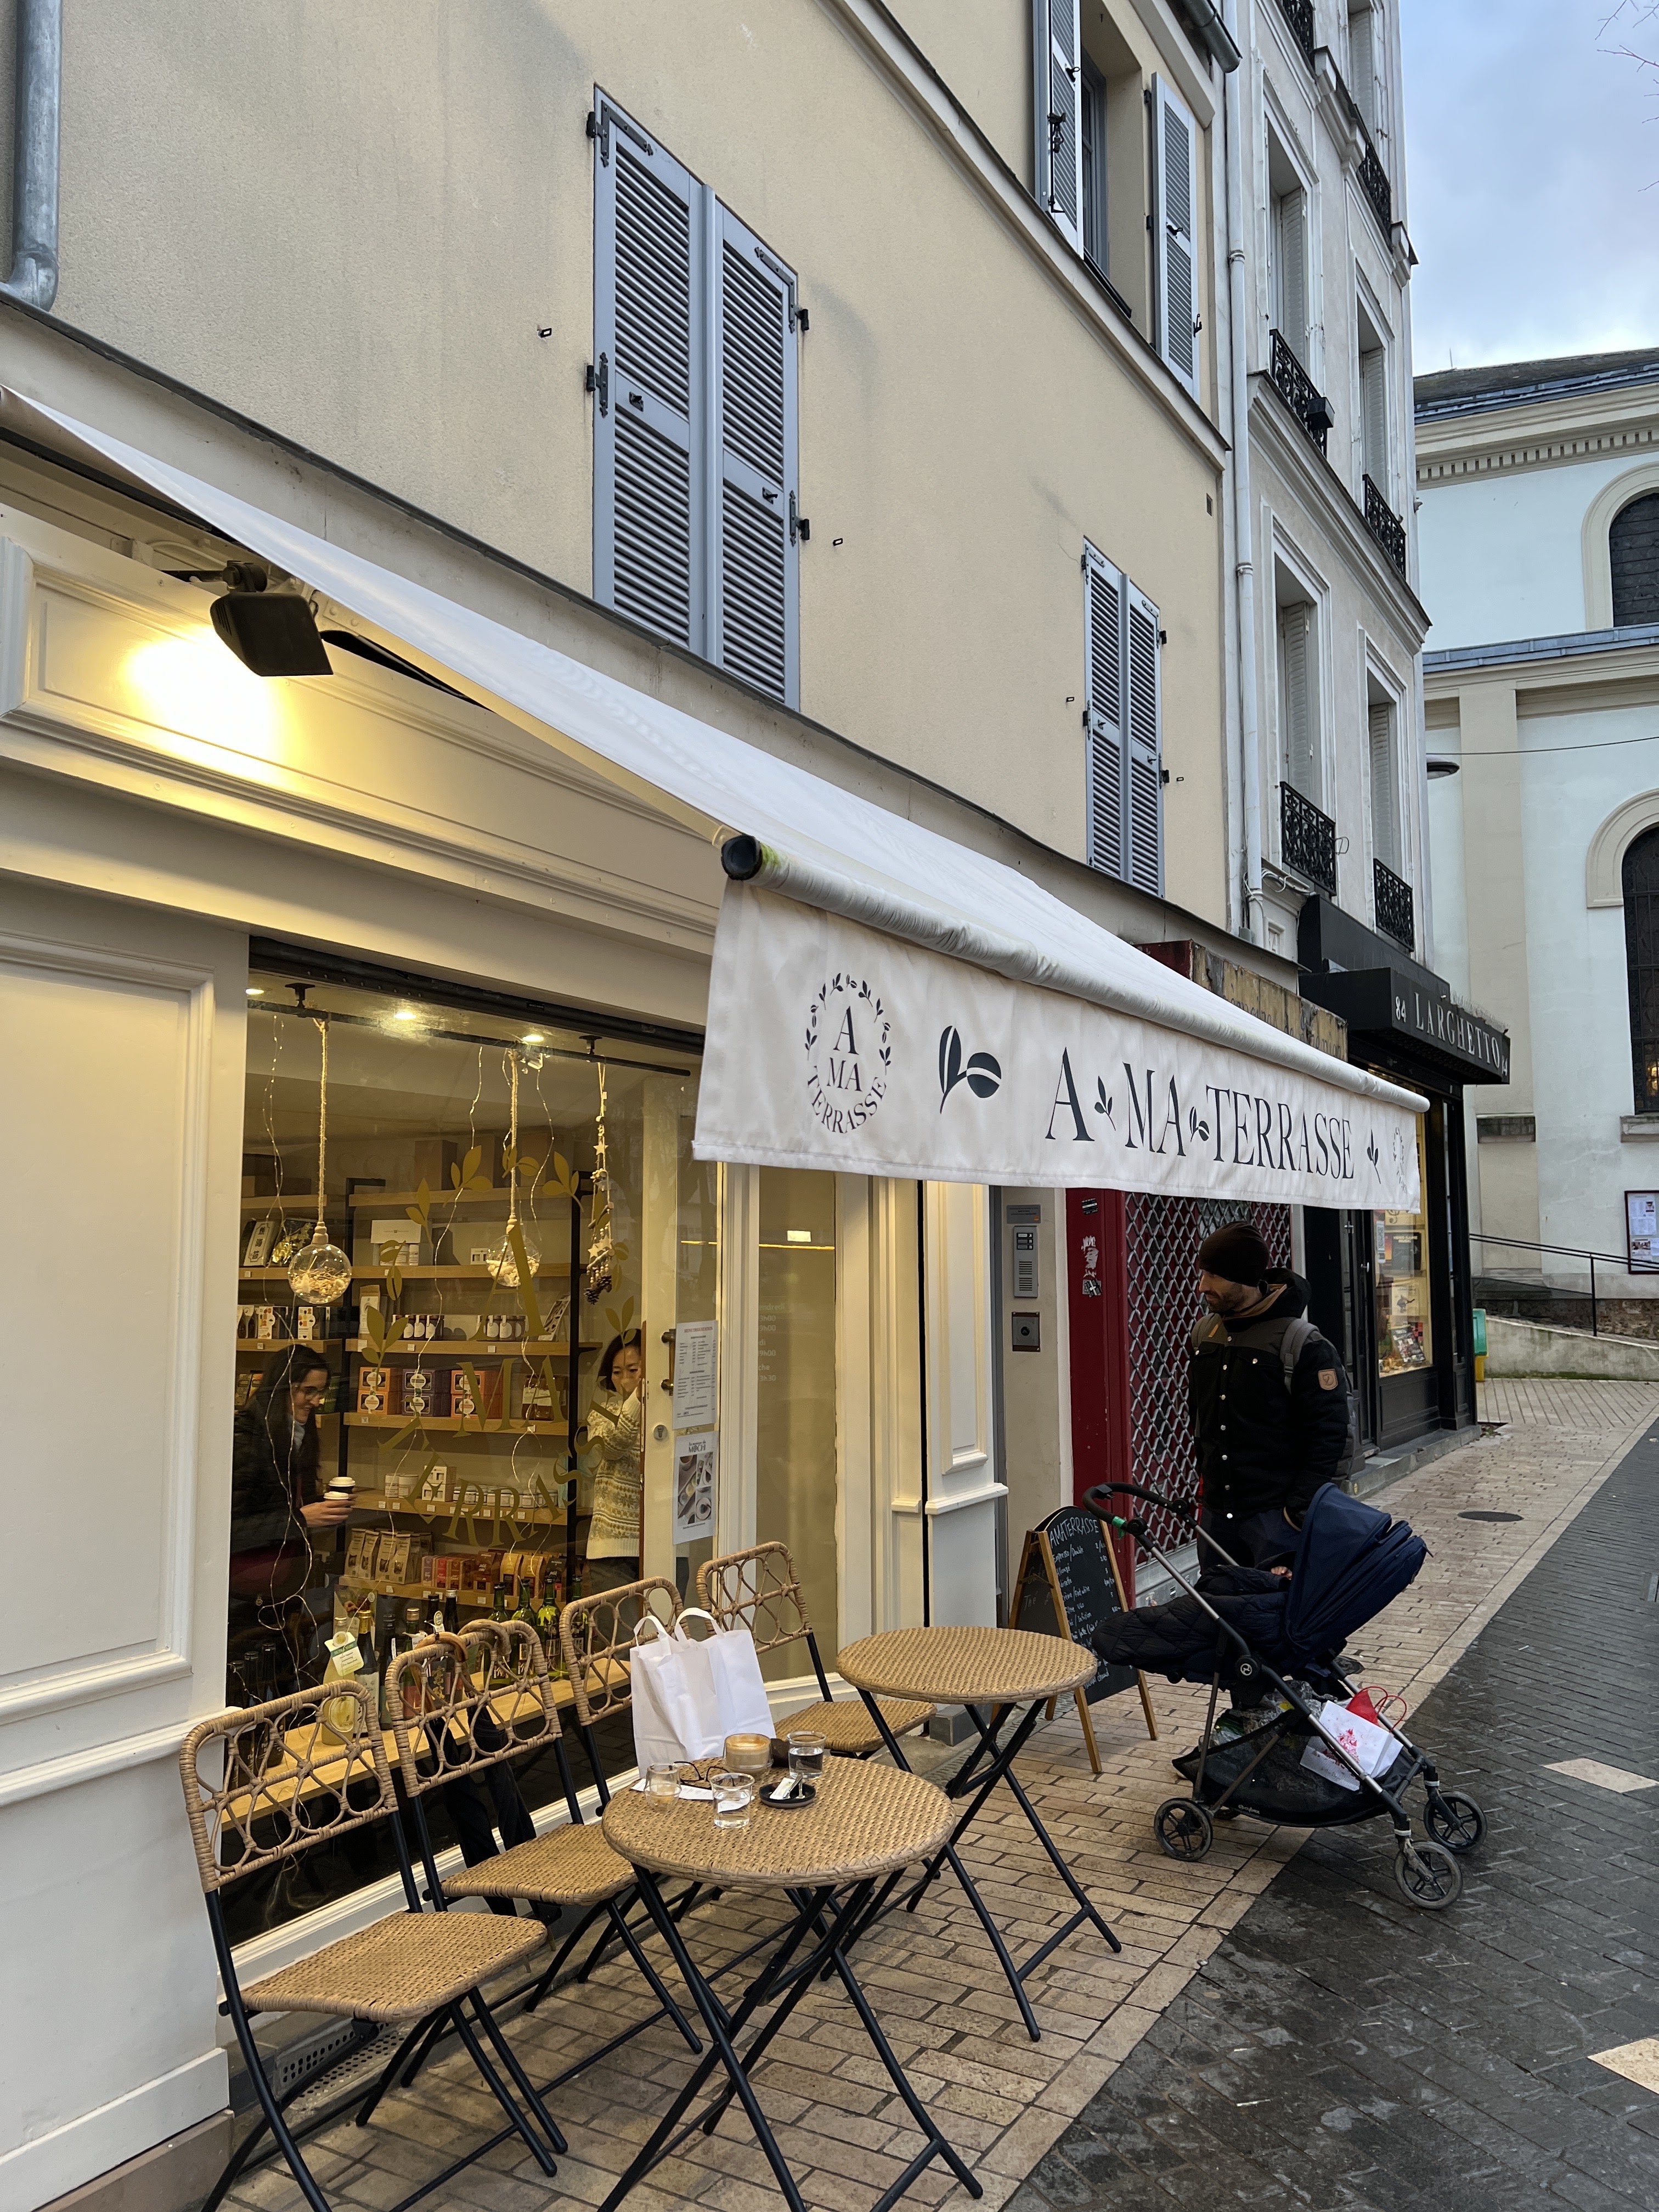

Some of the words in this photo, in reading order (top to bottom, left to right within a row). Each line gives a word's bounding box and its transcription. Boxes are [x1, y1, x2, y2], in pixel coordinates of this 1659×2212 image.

[833, 1006, 859, 1056] A
[1395, 996, 1406, 1023] 84
[1414, 992, 1500, 1068] LARGHETTO
[807, 1065, 887, 1134] TERRASSE
[826, 1057, 862, 1092] MA
[1045, 1046, 1095, 1142] A
[1122, 1061, 1187, 1157] MA
[1206, 1084, 1355, 1180] TERRASSE
[468, 1223, 551, 1342] A
[452, 1355, 568, 1438] MA
